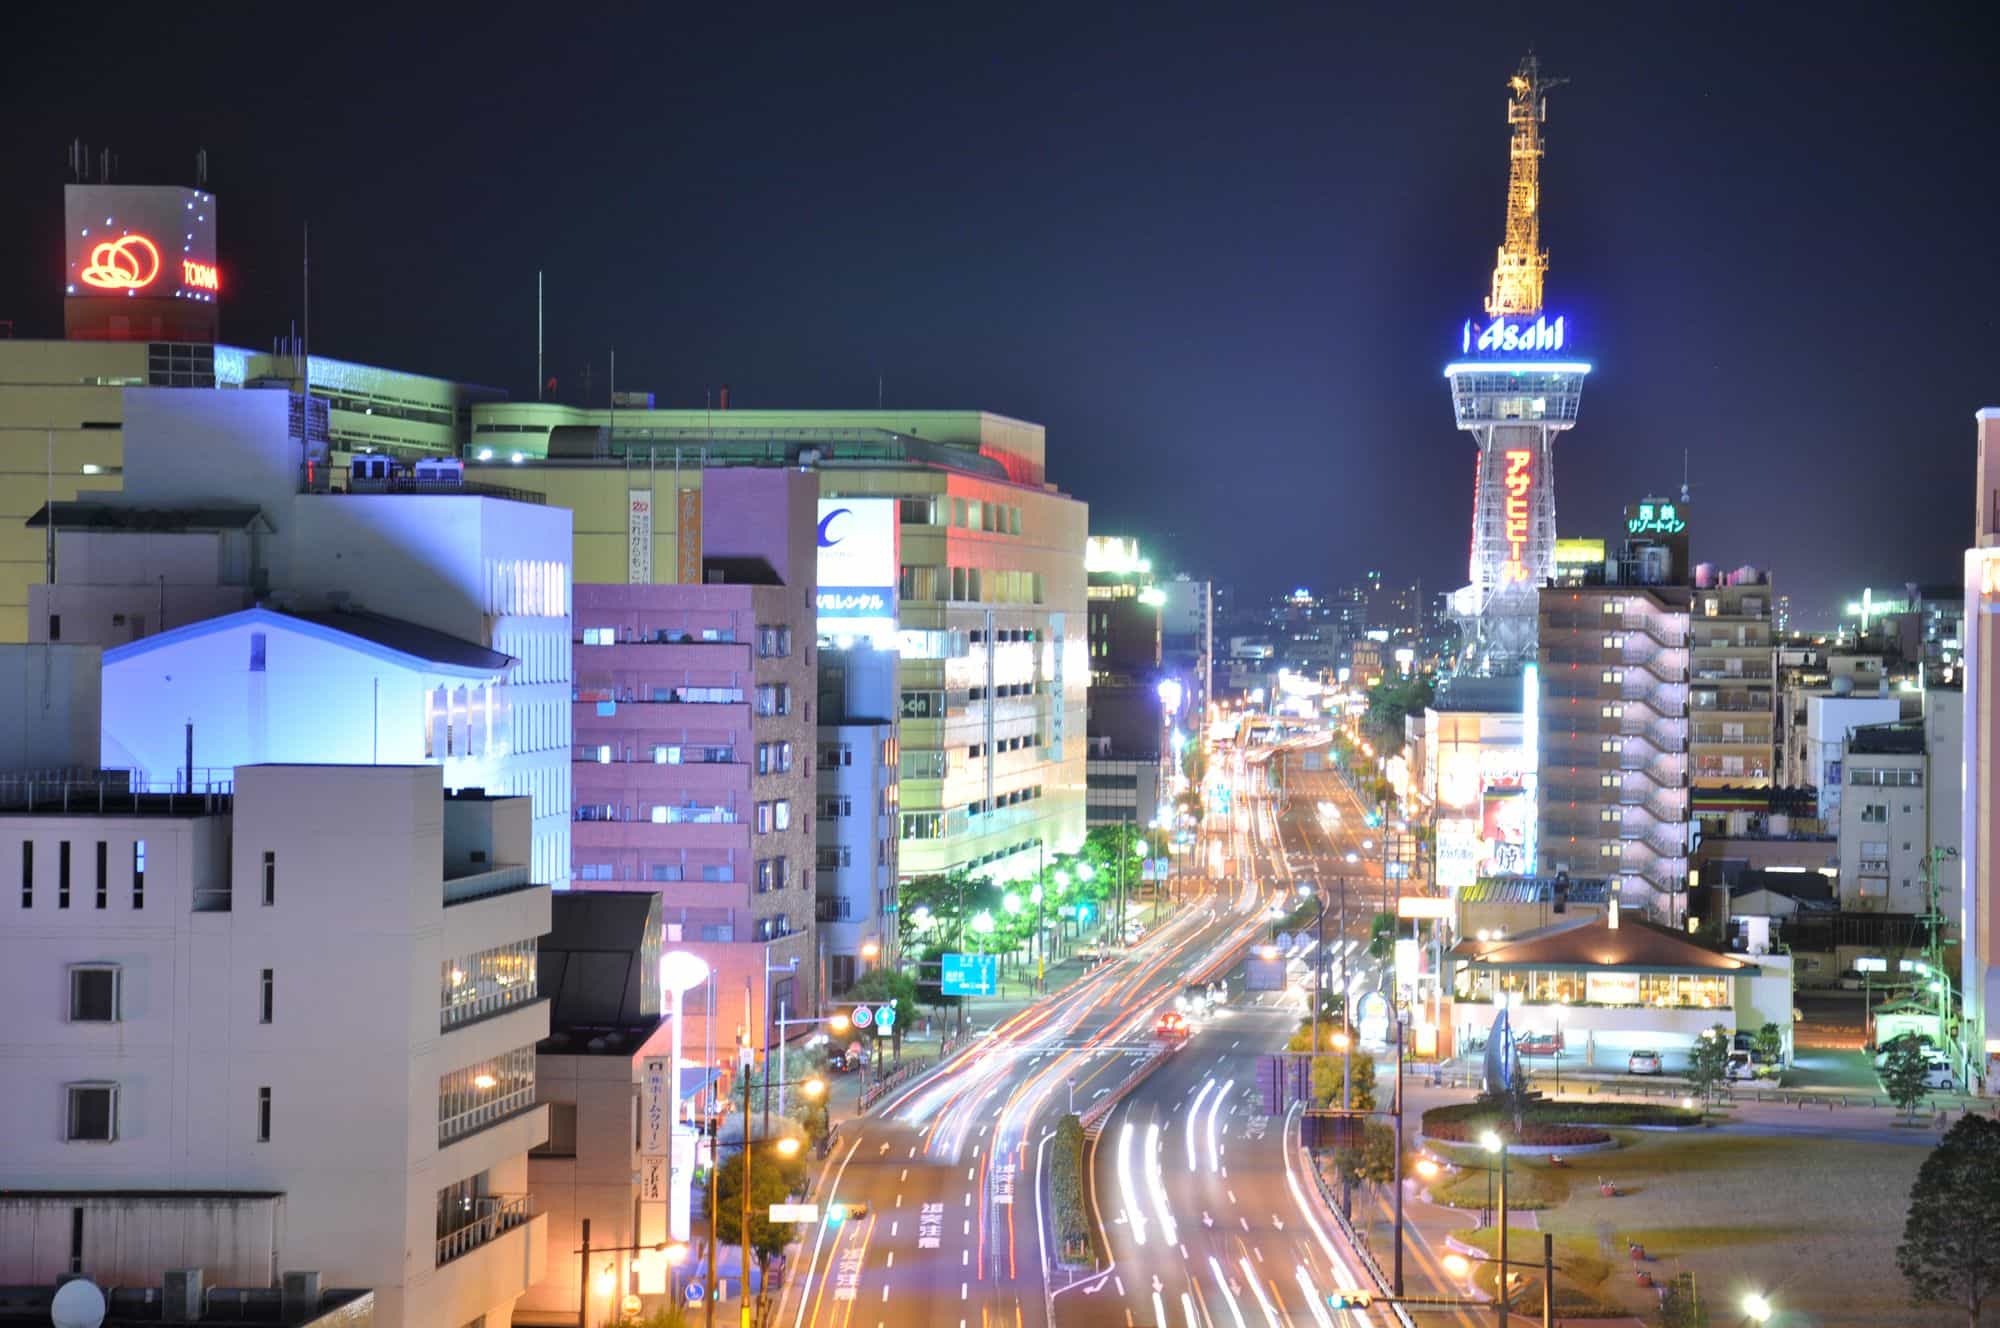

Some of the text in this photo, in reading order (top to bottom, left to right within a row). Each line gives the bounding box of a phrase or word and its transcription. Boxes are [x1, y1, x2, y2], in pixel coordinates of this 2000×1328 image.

[1478, 315, 1564, 351] Asahi
[1505, 450, 1531, 583] アサヒビール
[1054, 658, 1063, 743] TOKIWA
